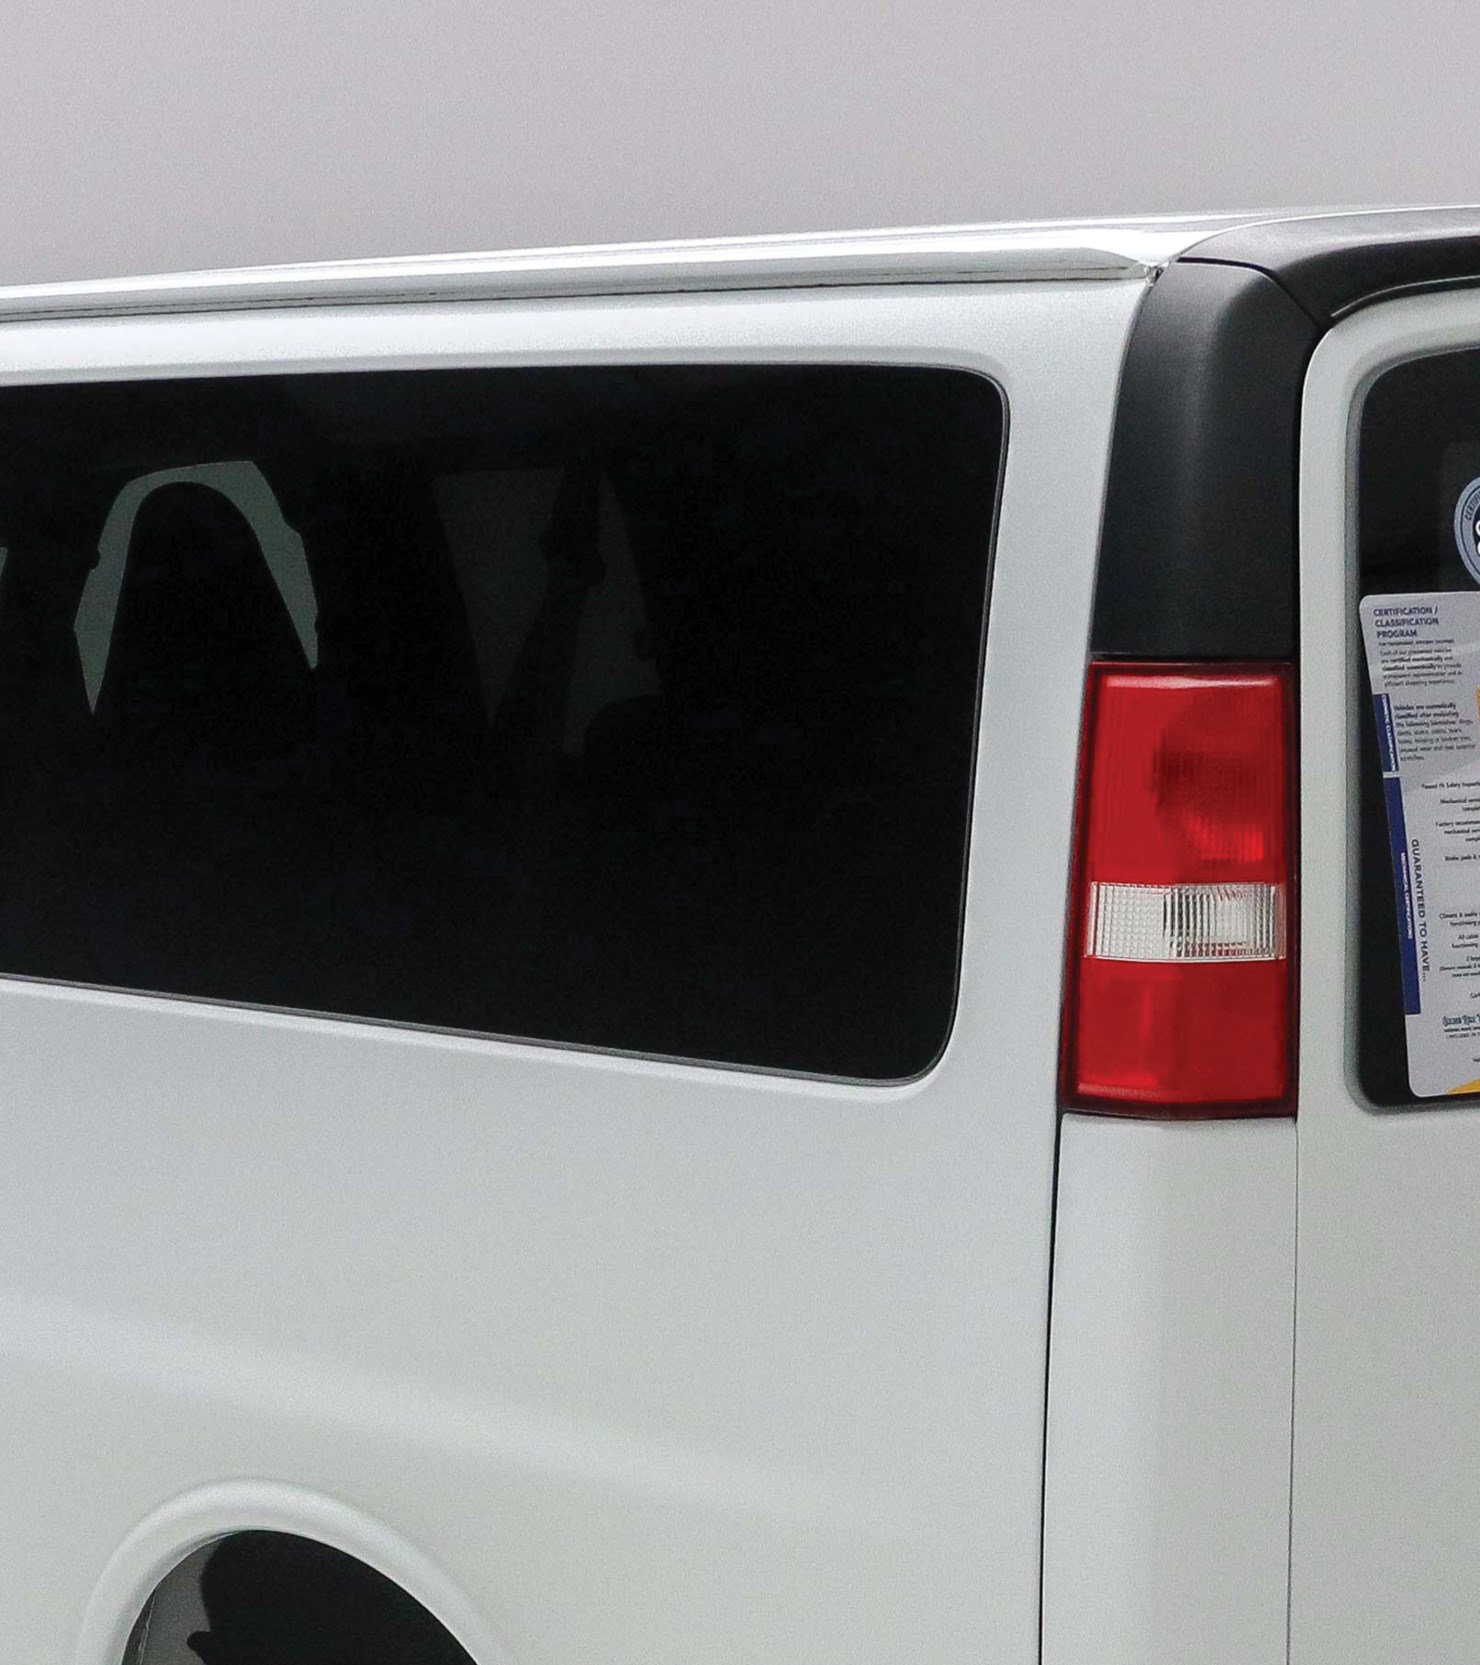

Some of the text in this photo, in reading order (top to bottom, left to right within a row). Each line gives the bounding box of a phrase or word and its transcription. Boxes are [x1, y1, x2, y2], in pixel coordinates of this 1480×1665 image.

[1373, 607, 1432, 617] CERTIFICATION
[1375, 618, 1439, 628] CLASSIFICATION
[1377, 629, 1418, 638] PROGRAM
[1411, 839, 1425, 917] GUARANTEED
[1418, 920, 1427, 938] TO
